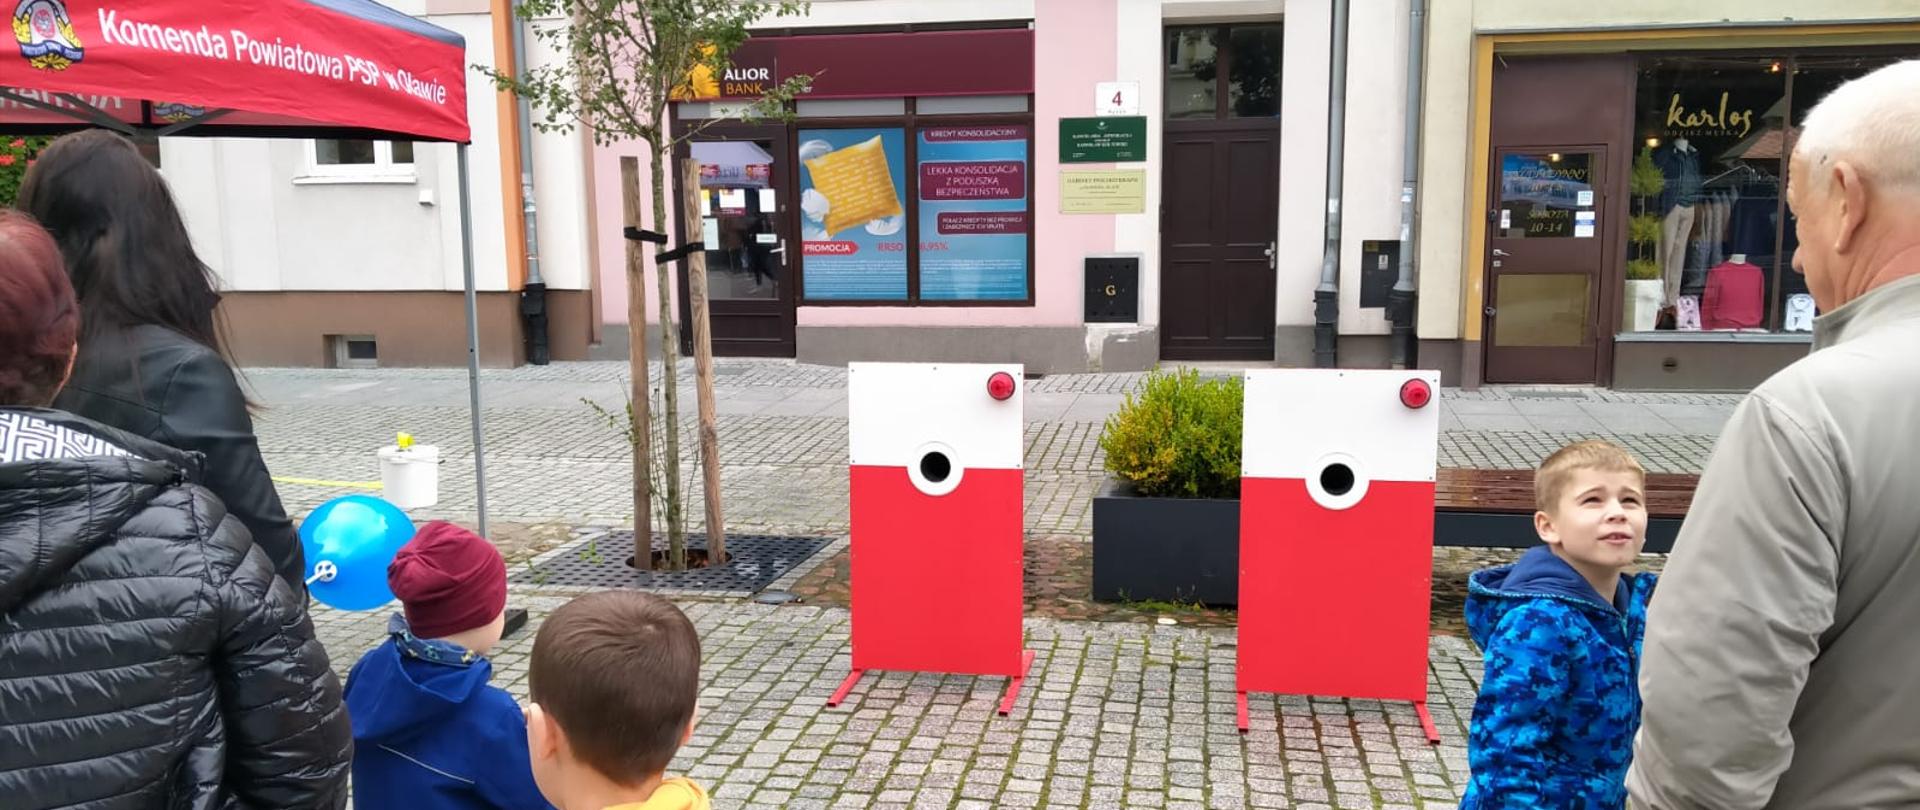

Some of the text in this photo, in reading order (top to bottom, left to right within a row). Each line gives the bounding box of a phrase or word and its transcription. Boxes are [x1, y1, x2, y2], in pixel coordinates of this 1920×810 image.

[98, 8, 228, 59] Komenda
[230, 30, 343, 80] Powiatowa
[344, 55, 379, 86] PSP
[382, 70, 398, 91] w
[398, 69, 447, 104] Oławie
[724, 67, 769, 81] ALIOR
[725, 83, 763, 95] BANK
[1112, 90, 1123, 106] 4
[1667, 91, 1753, 138] karlos
[931, 128, 1017, 138] KREDYT KONSOLIDACYJNY
[927, 164, 1018, 176] LEKKA KONSOLIDACJA
[946, 176, 999, 186] Z PODUSZKĄ
[936, 186, 1010, 197] BEZPIECZEŃSTWA
[1529, 222, 1563, 232] 10-14
[803, 243, 851, 253] PROMOCJA
[1106, 285, 1116, 296] G
